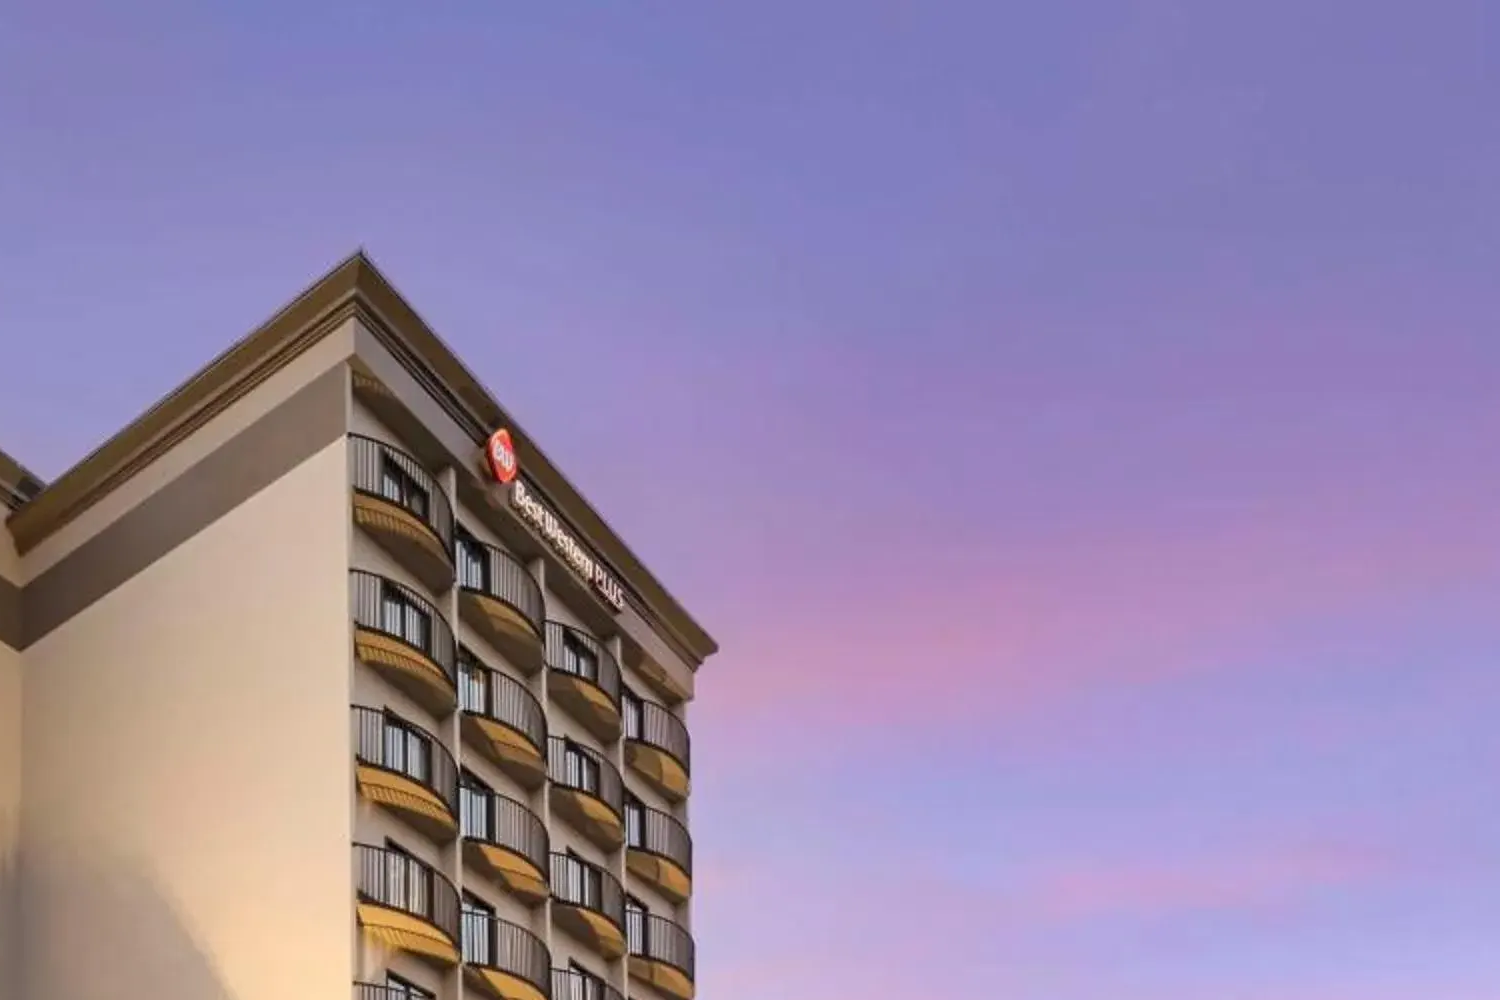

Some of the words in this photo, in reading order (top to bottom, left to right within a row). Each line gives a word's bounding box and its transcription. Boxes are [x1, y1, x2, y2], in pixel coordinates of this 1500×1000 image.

[515, 479, 544, 526] Best
[544, 510, 593, 579] Western
[595, 564, 624, 609] PLUS
